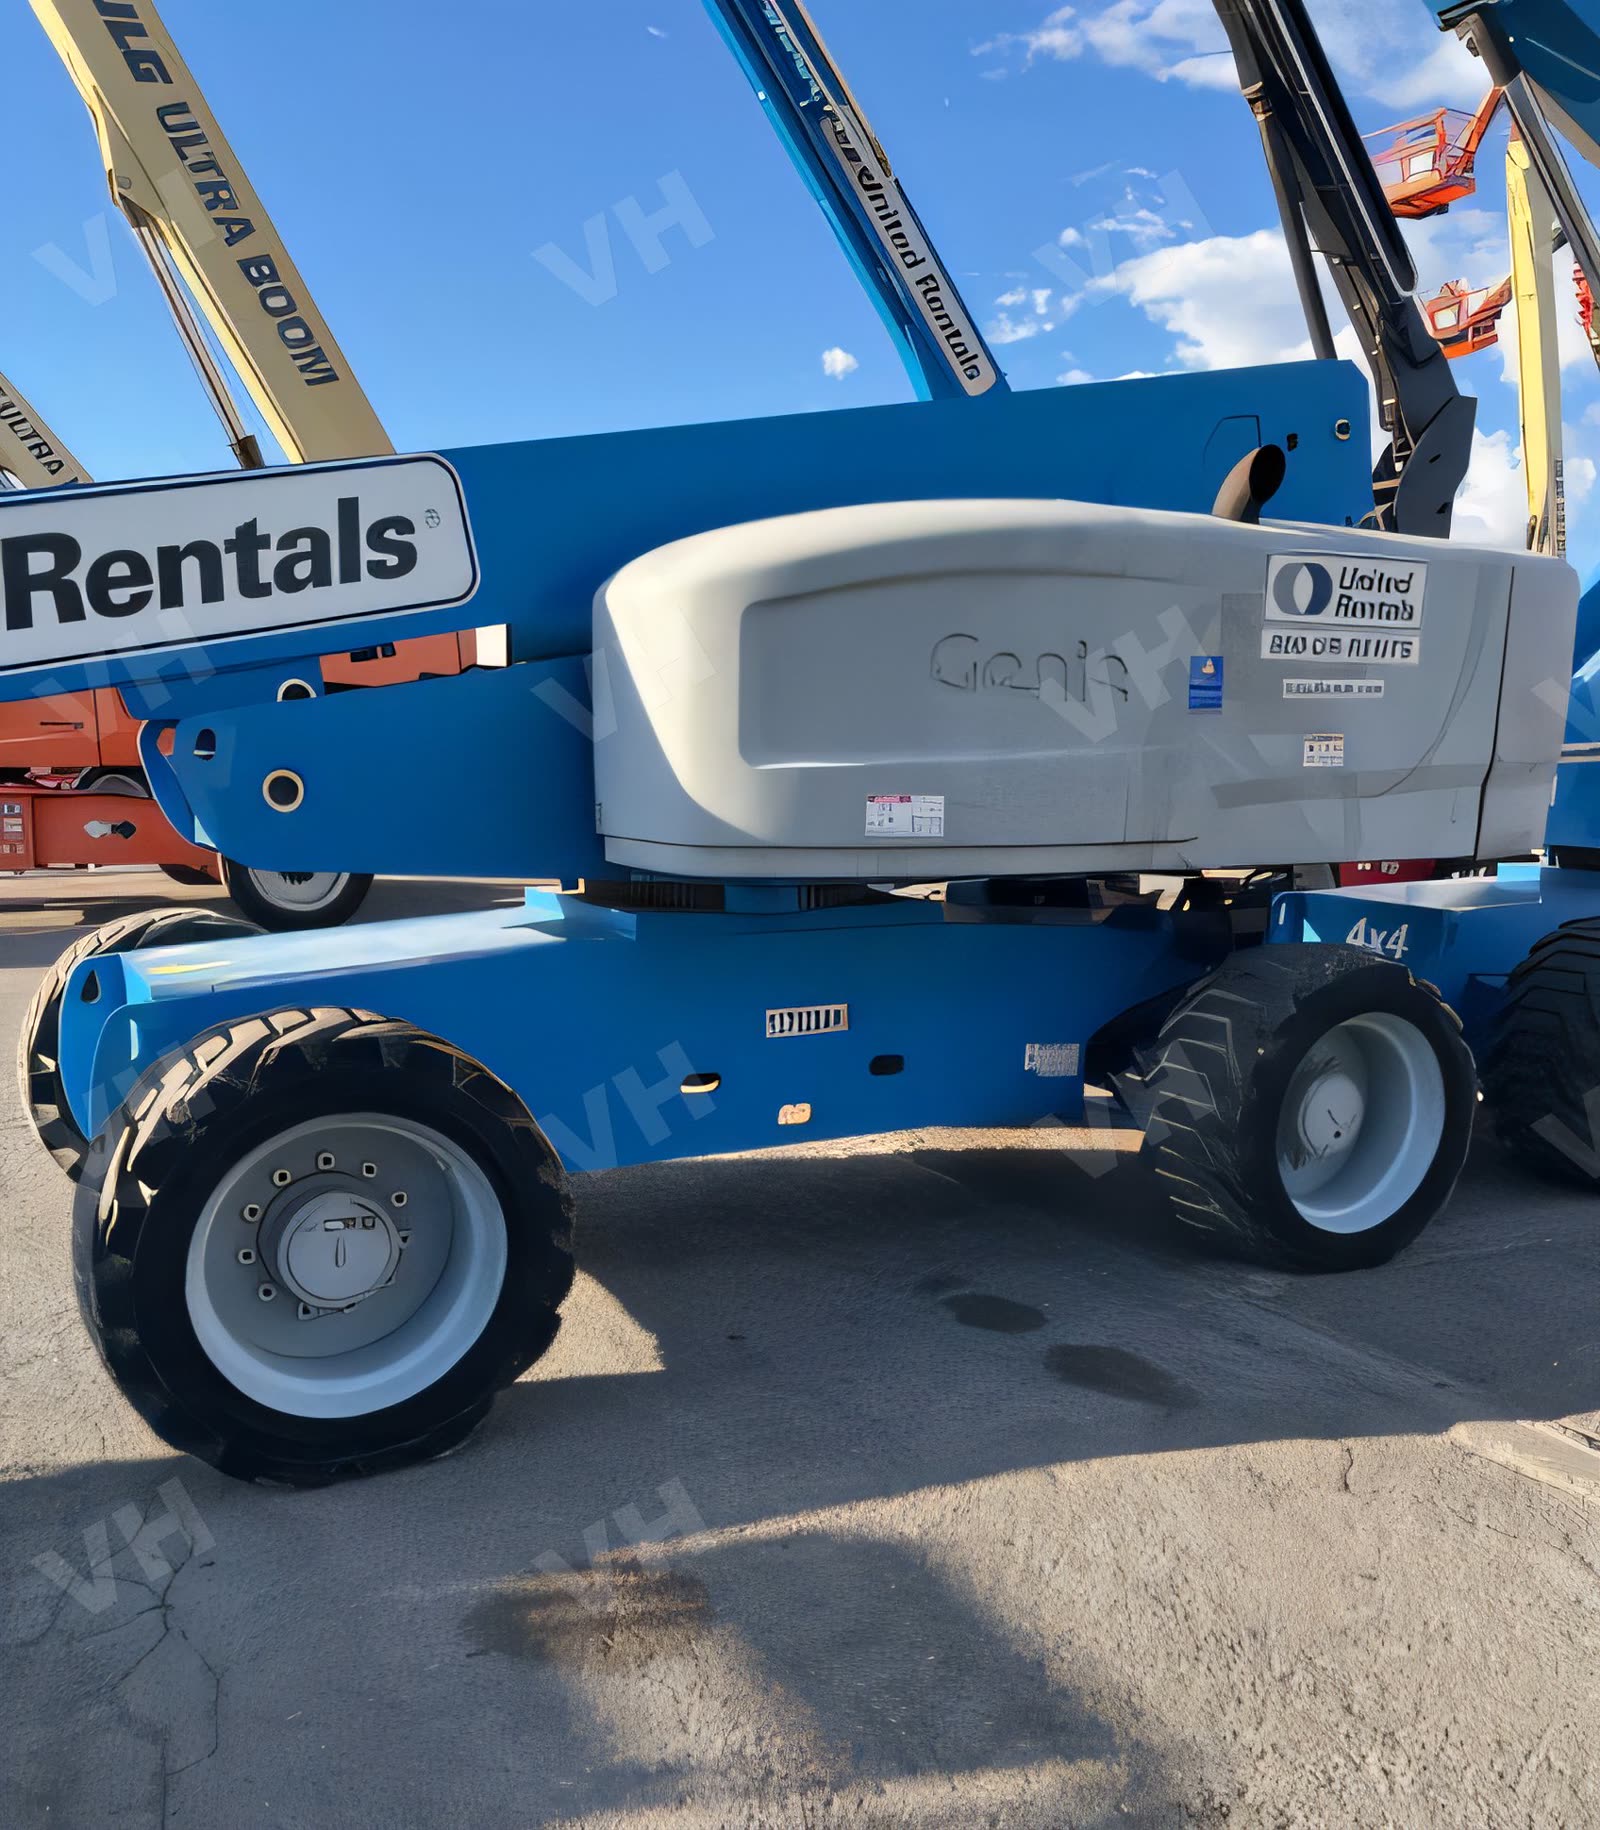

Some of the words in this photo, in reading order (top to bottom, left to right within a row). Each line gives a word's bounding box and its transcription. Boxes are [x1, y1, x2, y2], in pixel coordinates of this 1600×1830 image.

[156, 102, 256, 247] ULTRA
[236, 254, 339, 386] BOOM
[2, 496, 418, 631] Rentals
[1346, 917, 1409, 959] 4x4
